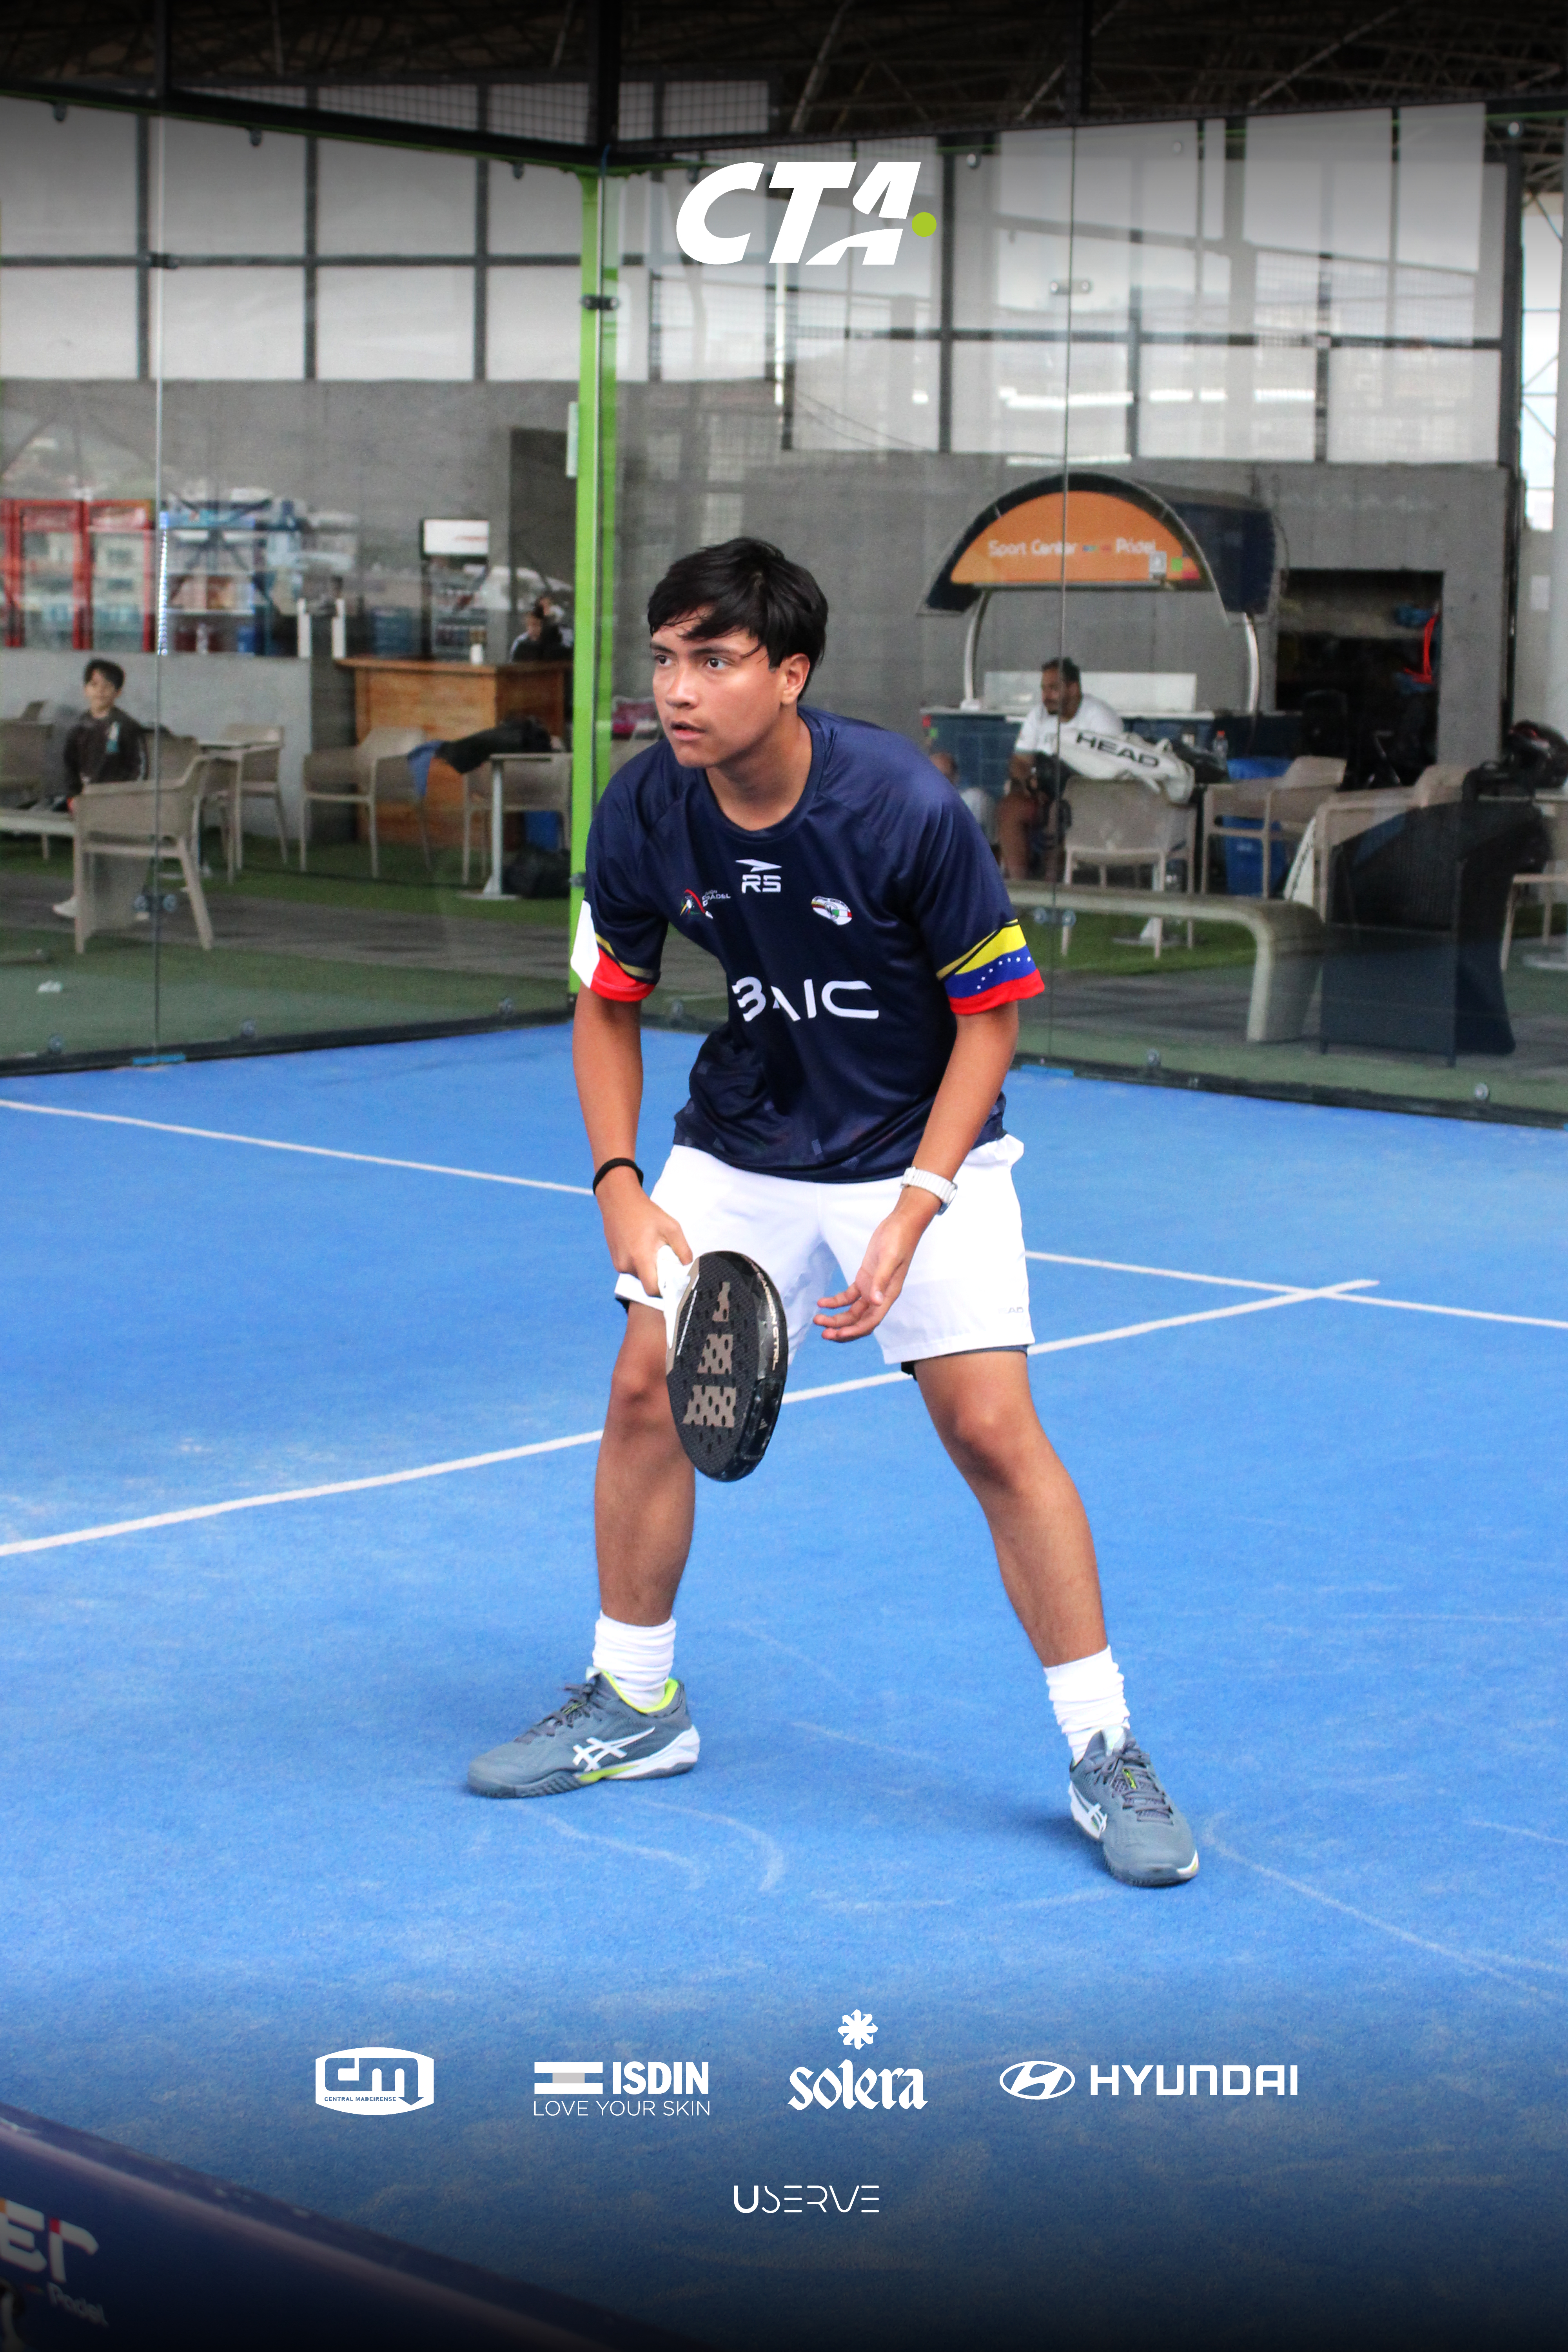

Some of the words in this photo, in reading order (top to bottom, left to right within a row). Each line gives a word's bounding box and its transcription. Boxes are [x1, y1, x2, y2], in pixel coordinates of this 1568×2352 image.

[988, 539, 1026, 557] Sport
[1031, 538, 1078, 556] Center
[1076, 732, 1160, 768] HEAD
[731, 976, 879, 1022] BAIC
